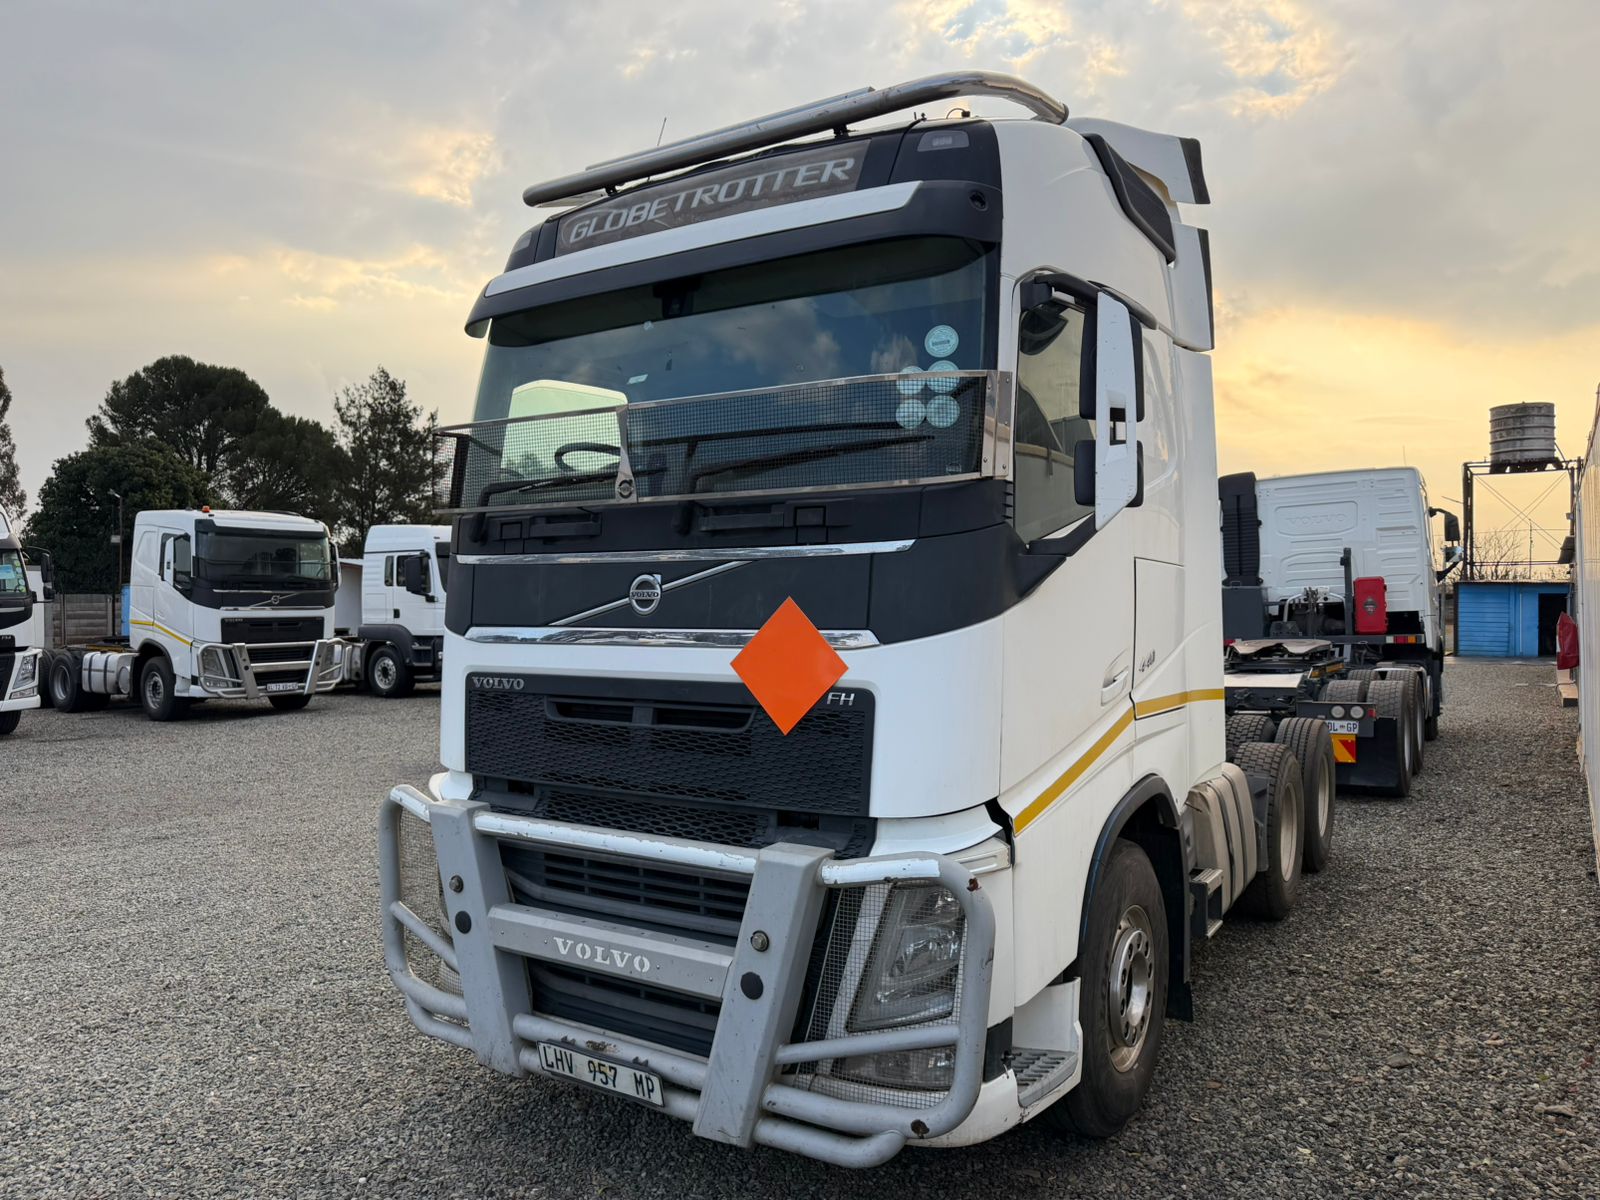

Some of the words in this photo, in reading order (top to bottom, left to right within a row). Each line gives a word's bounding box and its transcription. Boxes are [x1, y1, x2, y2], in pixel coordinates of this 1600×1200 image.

[569, 157, 856, 245] GLOBETROTTER
[471, 676, 525, 690] VOLVO
[826, 691, 855, 706] FH
[1346, 722, 1358, 732] GP
[553, 936, 651, 973] VOLVO
[542, 1045, 574, 1075] LHV
[587, 1060, 618, 1089] 957
[633, 1071, 656, 1100] MP
